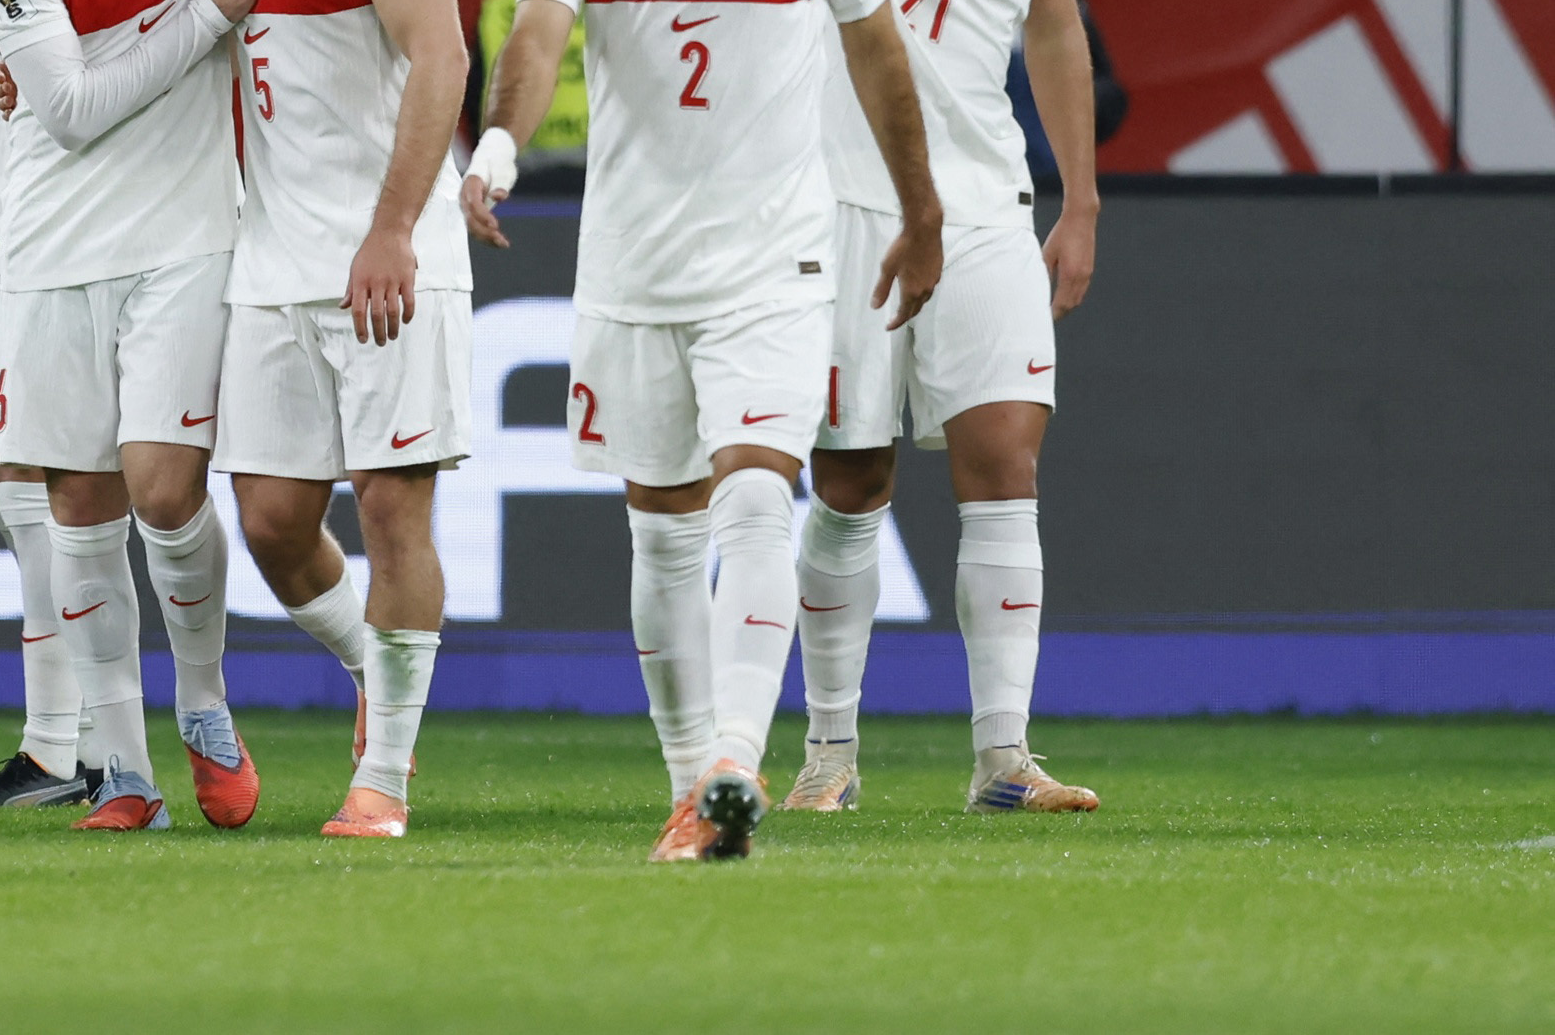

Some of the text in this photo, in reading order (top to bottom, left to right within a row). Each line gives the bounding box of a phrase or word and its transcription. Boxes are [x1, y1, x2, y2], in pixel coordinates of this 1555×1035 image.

[251, 57, 275, 123] 5
[679, 40, 711, 111] 2
[572, 382, 606, 446] 2
[828, 365, 840, 429] 1
